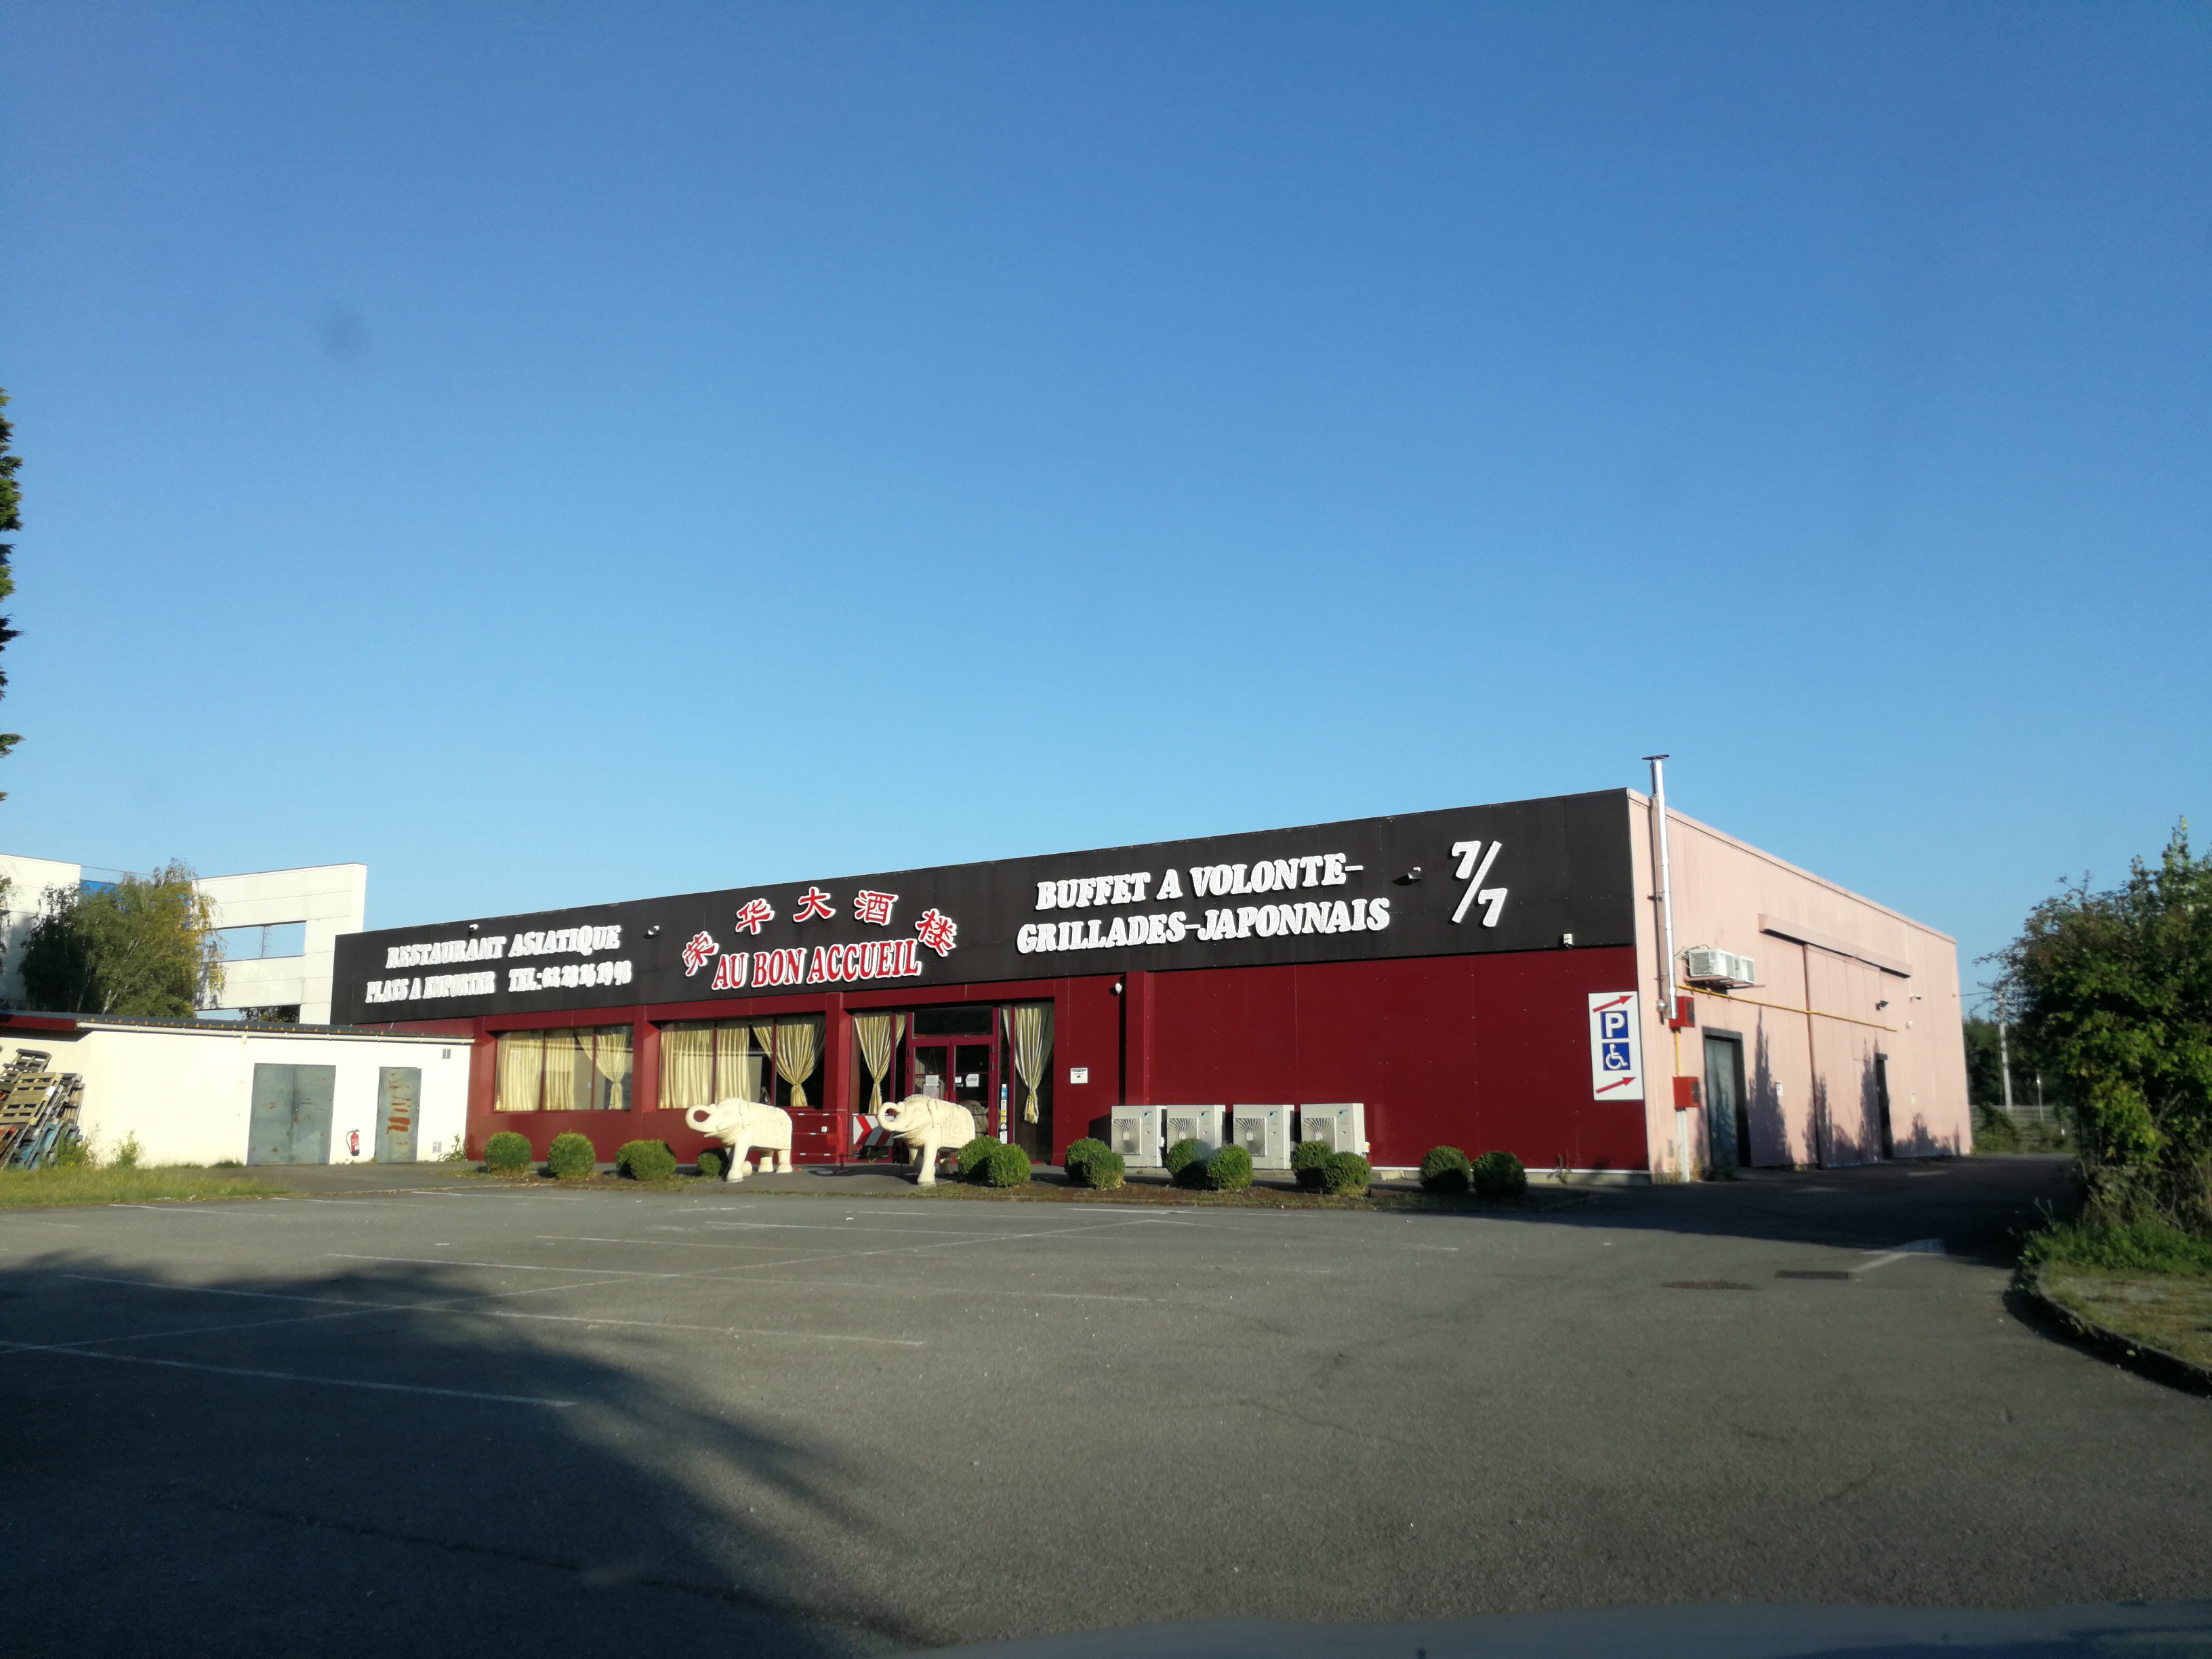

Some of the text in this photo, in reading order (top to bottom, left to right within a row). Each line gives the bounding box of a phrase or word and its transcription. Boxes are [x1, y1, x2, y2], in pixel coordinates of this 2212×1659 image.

[1036, 872, 1150, 909] BUFFET
[1156, 869, 1183, 901] A
[1452, 841, 1507, 927] 7/7
[386, 925, 621, 968] RESTAURANT ASIATIQUE
[712, 939, 922, 990] AU BON ACCUEIL
[365, 979, 409, 1003] PLATS
[409, 977, 421, 1000] A
[423, 971, 495, 999] EMPORTER
[1605, 1012, 1625, 1038] P
